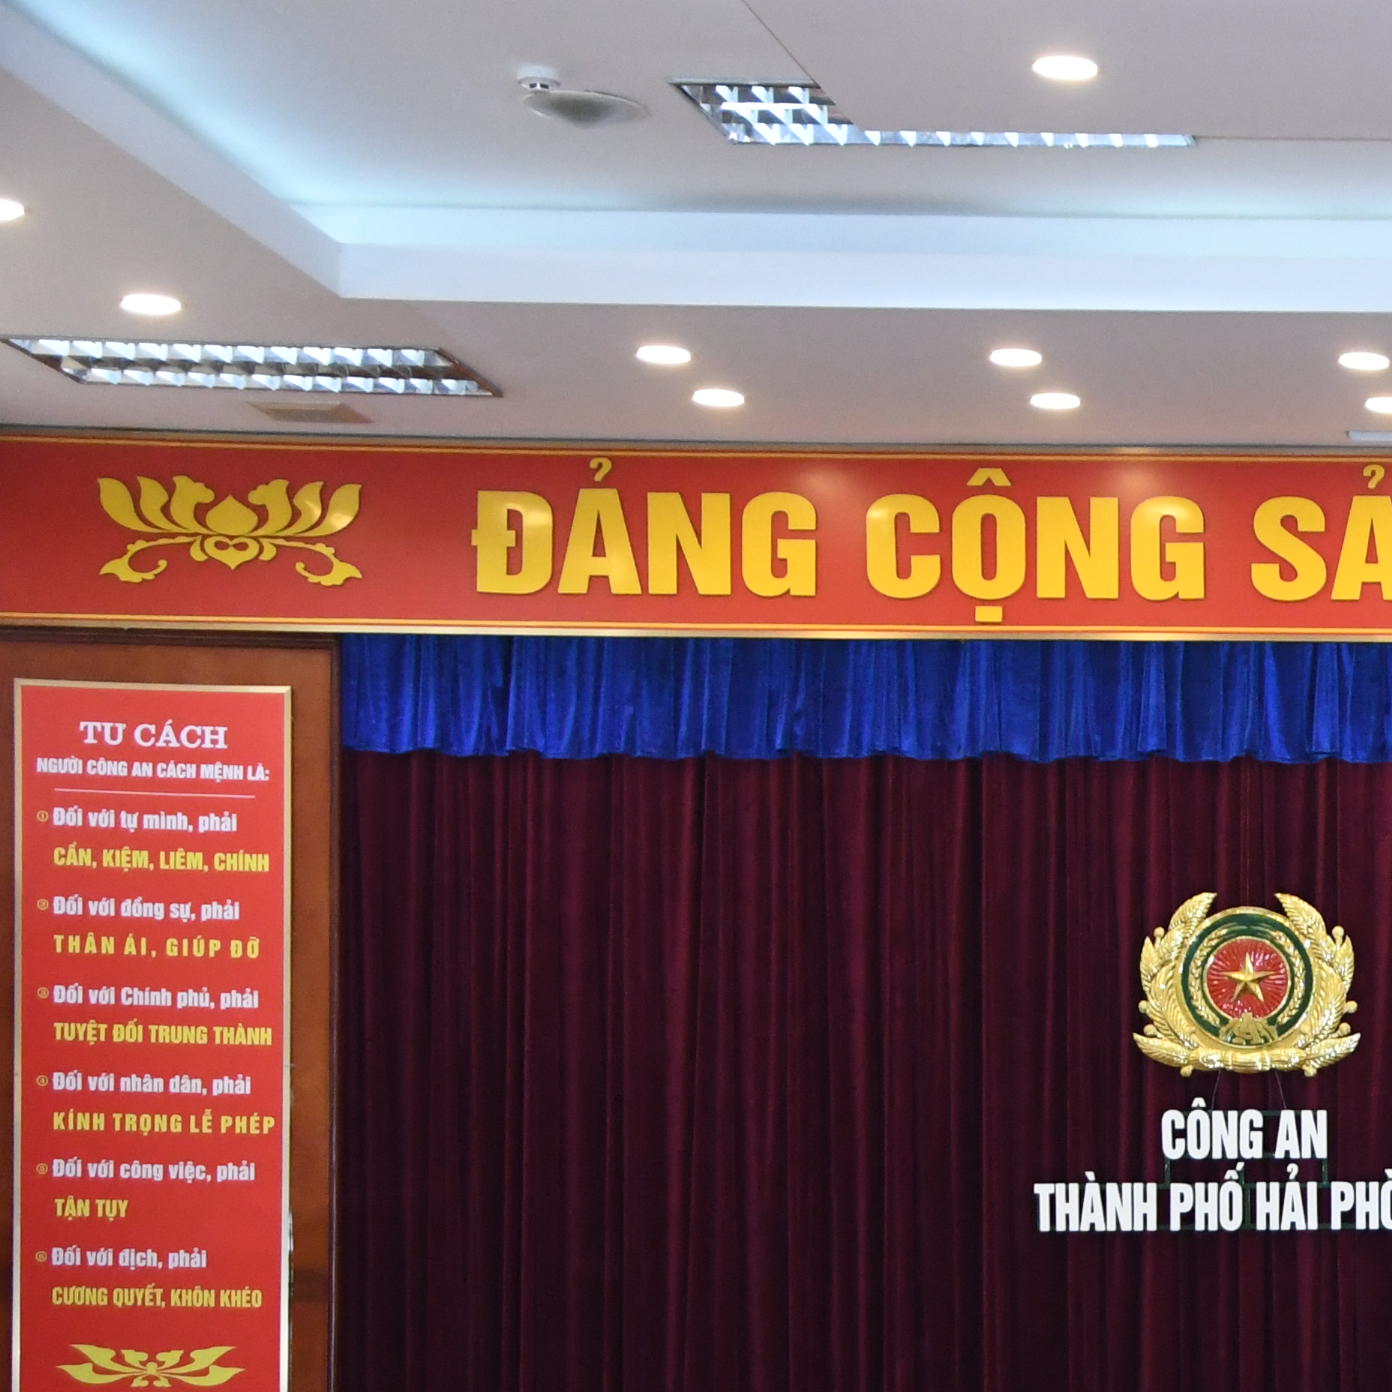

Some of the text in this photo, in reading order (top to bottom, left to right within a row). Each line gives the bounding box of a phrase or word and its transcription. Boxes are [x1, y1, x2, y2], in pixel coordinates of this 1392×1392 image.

[472, 456, 818, 598] ĐẢNG
[867, 468, 1206, 624] CỘNG
[80, 720, 228, 748] TƯ CÁCH
[87, 758, 128, 776] CÔNG
[132, 762, 152, 777] AN
[157, 760, 196, 778] CÁCH
[200, 762, 243, 782] MỆNH
[247, 763, 269, 780] LÀ:
[53, 806, 237, 832] Đối với tự mình, phải
[103, 846, 154, 872] KIỆM,
[160, 848, 208, 872] LIÊM,
[214, 850, 269, 872] CHÍNH
[53, 894, 82, 914] Đối
[88, 898, 115, 916] với
[121, 896, 164, 920] đồng
[201, 900, 239, 921] phải
[54, 932, 114, 954] THÂN
[124, 934, 156, 957] ÁI,
[166, 936, 220, 957] GIÚP
[54, 983, 82, 1004] Đối
[89, 986, 115, 1004] với
[121, 987, 172, 1006] Chính
[220, 988, 258, 1010] phải
[54, 1020, 272, 1045] TUYỆT ĐỐI TRUNG THÀNH
[53, 1070, 250, 1096] Đối với nhân dân, phải
[54, 1109, 104, 1130] KÍNH
[113, 1114, 182, 1136] TRỌNG
[221, 1112, 274, 1134] PHÉP
[1162, 1098, 1327, 1159] CÔNG AN
[52, 1157, 255, 1182] Đối với công việc, phải
[55, 1196, 128, 1221] TẬN TỤY
[1034, 1172, 1156, 1232] THÀNH
[1170, 1164, 1244, 1231] PHỐ
[1256, 1164, 1318, 1230] HẢI
[52, 1245, 206, 1270] Đối với dịch, phải
[52, 1284, 262, 1308] CƯƠNG QUYẾT, KHÔN KHÉO
